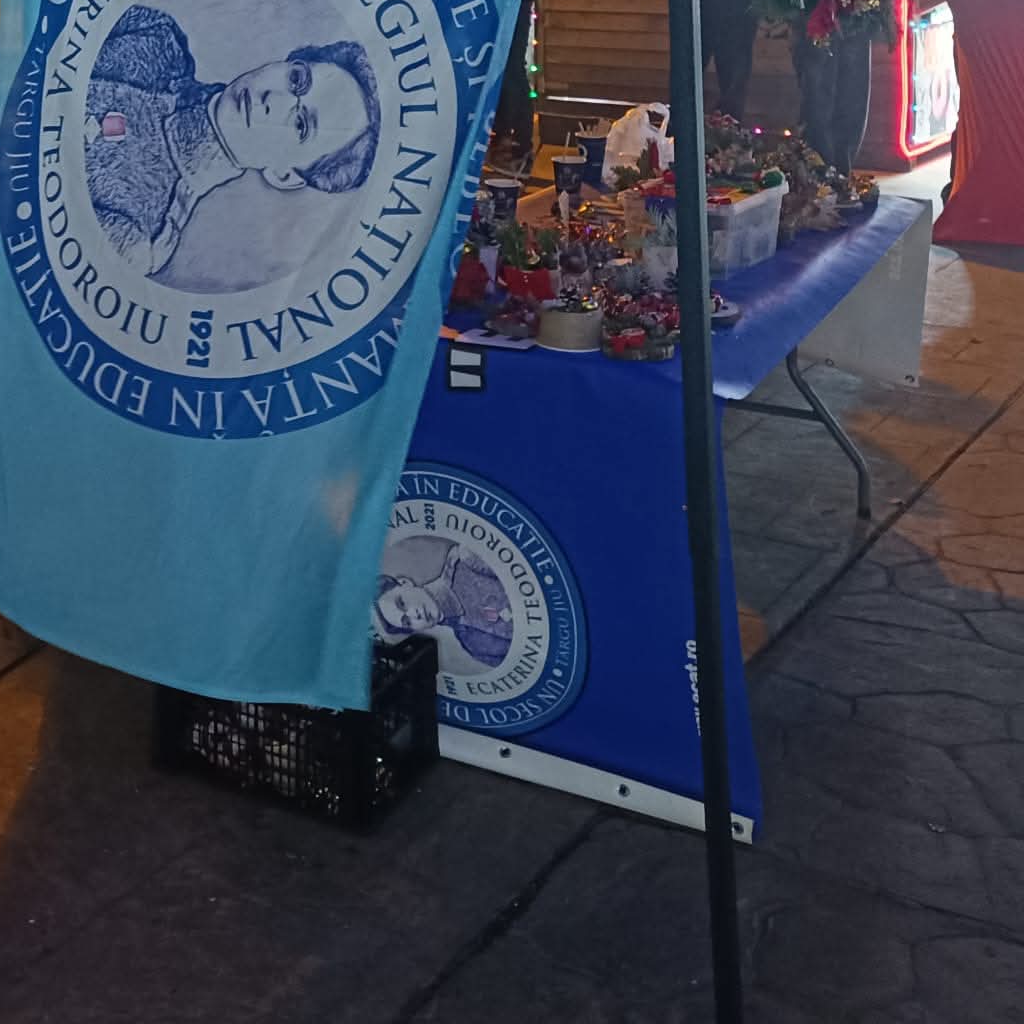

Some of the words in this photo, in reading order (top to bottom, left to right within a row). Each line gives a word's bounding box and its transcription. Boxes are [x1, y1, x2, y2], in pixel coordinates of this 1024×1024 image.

[5, 151, 32, 193] JIU
[42, 115, 168, 344] TEODOROIU
[227, 142, 438, 361] NAȚIONAL
[7, 225, 153, 417] EDUCAȚIE
[186, 310, 214, 368] 1921
[423, 503, 436, 531] 2021
[446, 513, 543, 624] TEODOROIU
[551, 589, 569, 611] JIU
[466, 635, 543, 696] ECATERINA
[537, 679, 565, 705] UN
[479, 698, 543, 724] SECOL
